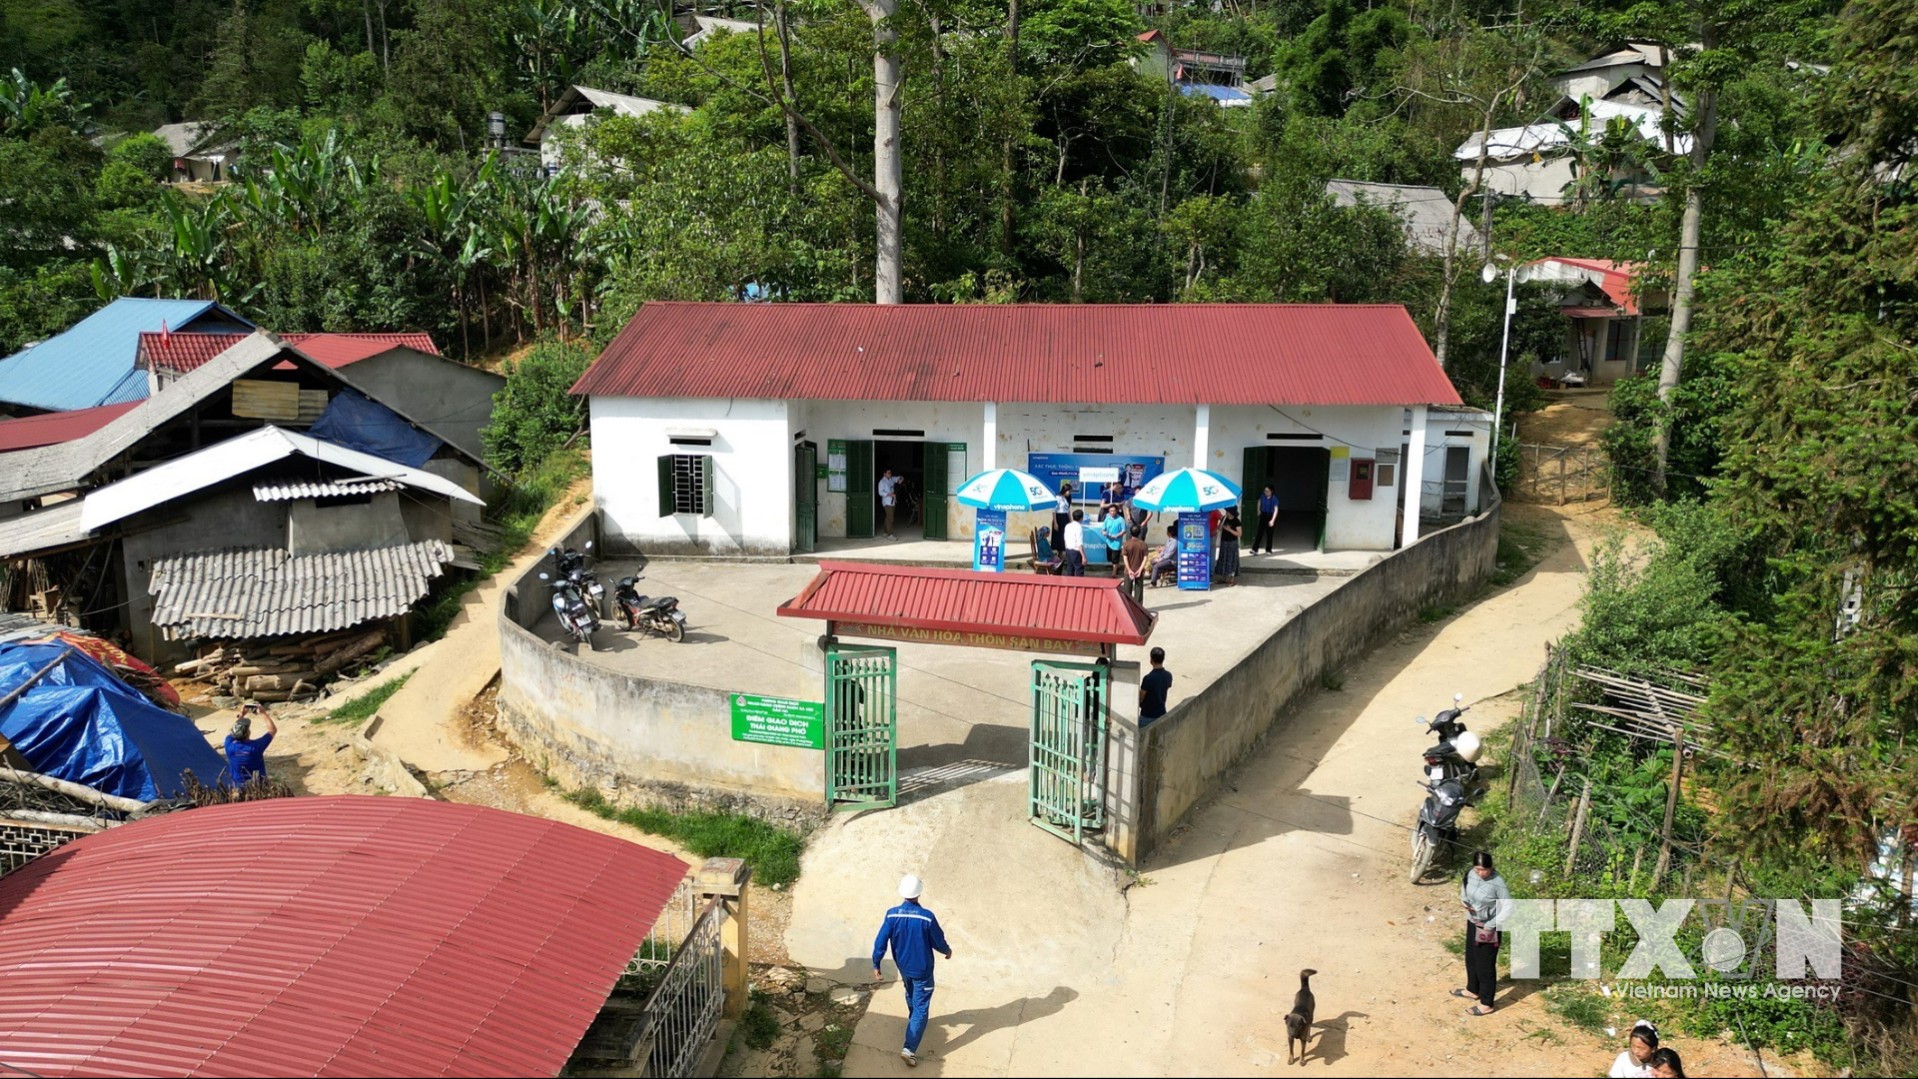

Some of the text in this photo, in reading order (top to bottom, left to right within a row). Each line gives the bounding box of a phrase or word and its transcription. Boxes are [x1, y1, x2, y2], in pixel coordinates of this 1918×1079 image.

[993, 503, 1026, 511] vinaphone
[1043, 640, 1074, 651] BAY
[766, 717, 787, 725] GIAO
